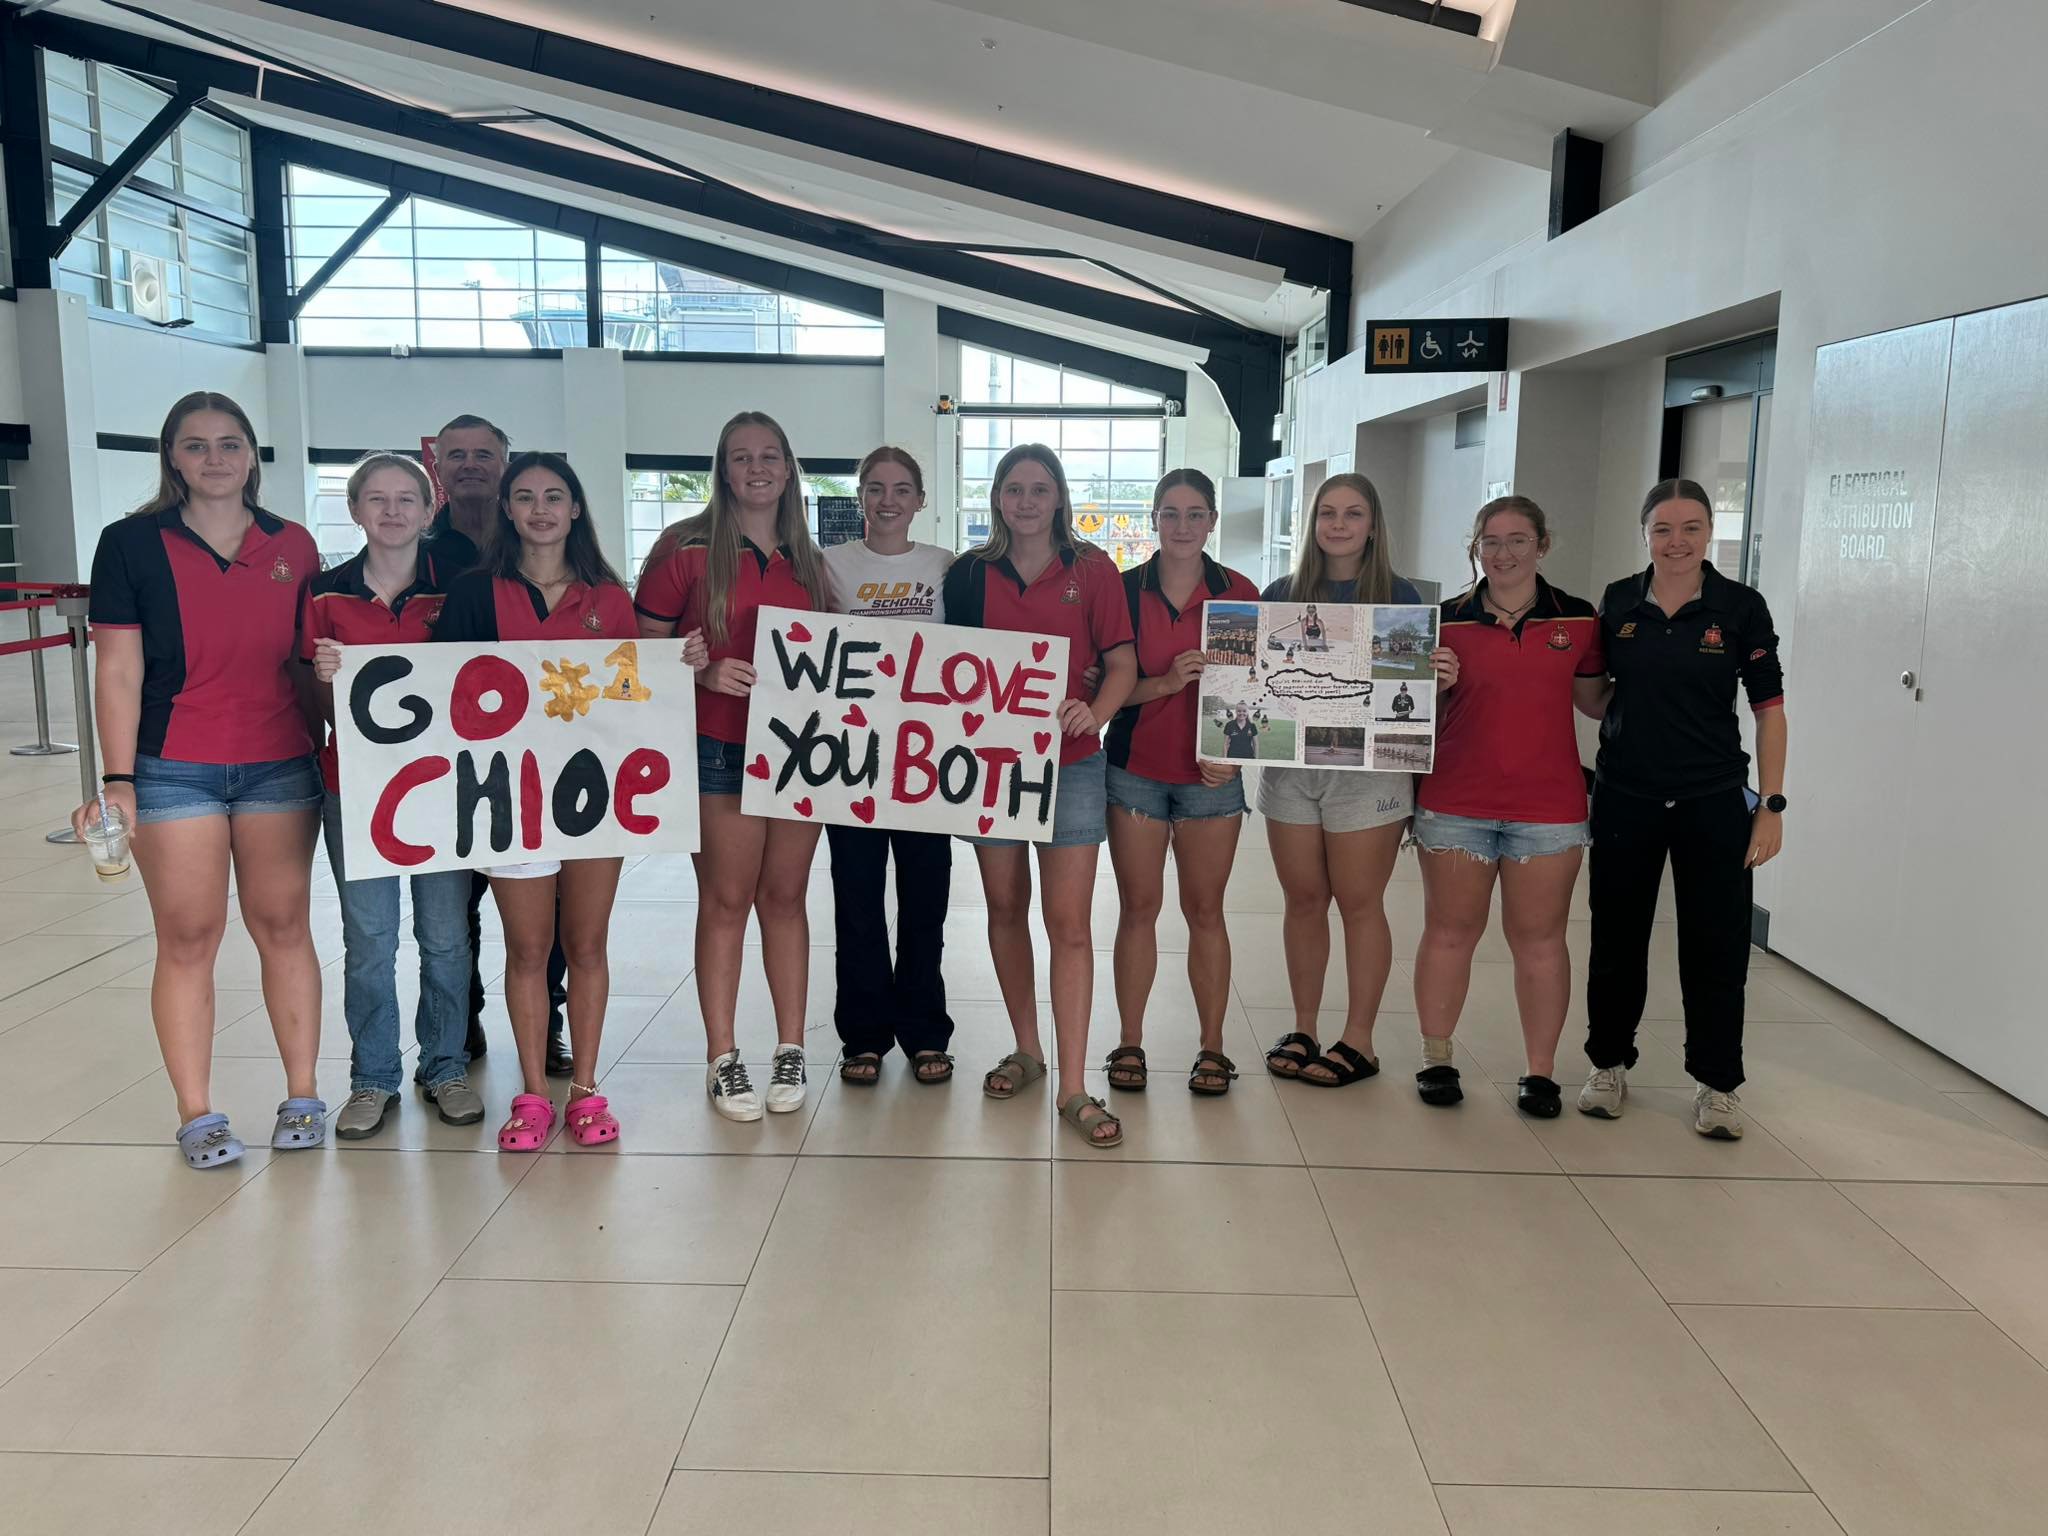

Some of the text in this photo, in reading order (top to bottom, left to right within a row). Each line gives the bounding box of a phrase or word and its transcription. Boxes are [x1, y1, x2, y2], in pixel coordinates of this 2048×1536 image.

[1840, 534, 1885, 559] BOARD
[856, 582, 912, 602] QLD
[349, 655, 530, 744] GO
[771, 626, 1056, 718] WE LOVE
[768, 710, 1054, 826] YOU BOTH
